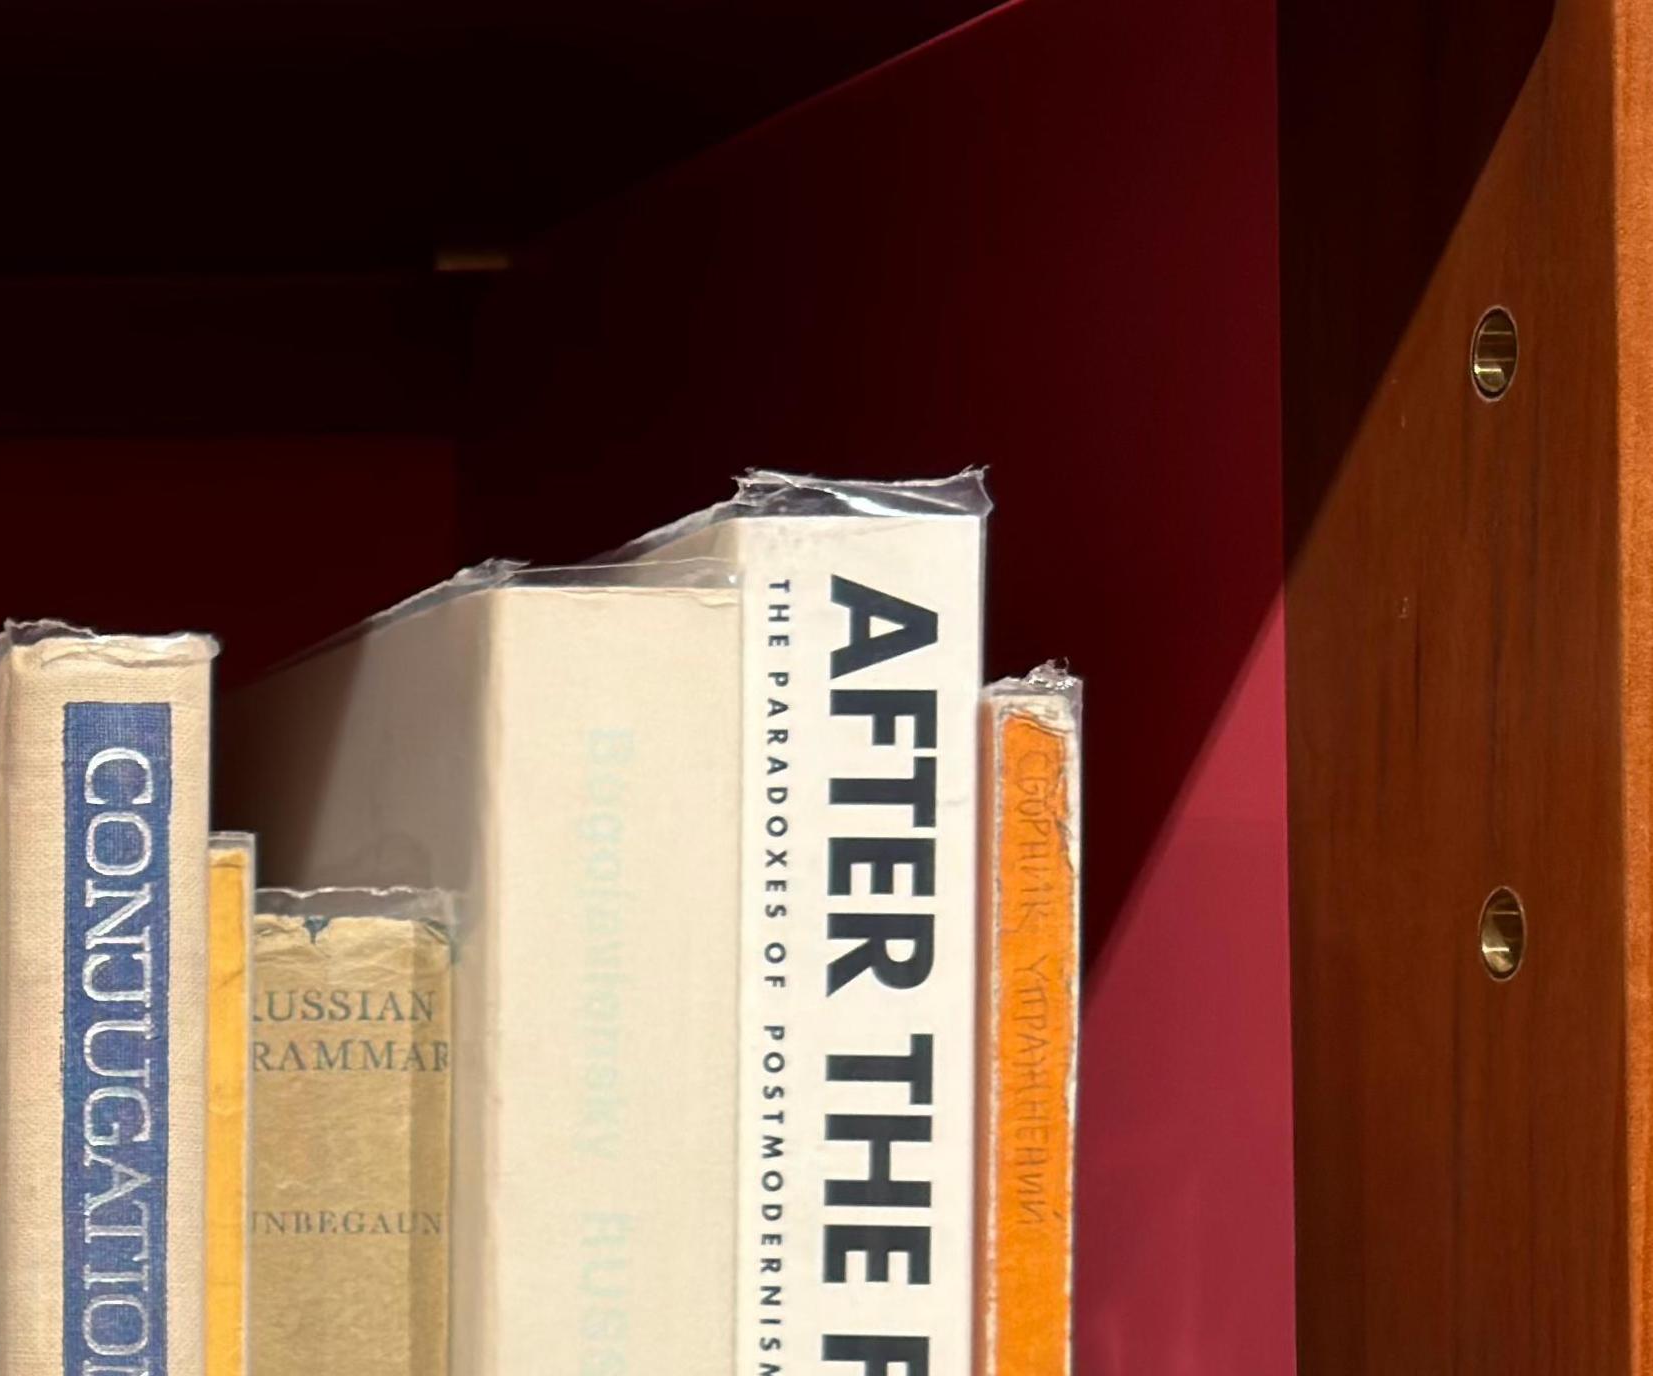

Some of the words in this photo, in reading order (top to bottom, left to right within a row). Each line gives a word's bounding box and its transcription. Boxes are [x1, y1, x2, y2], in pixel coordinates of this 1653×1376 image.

[765, 579, 792, 648] THE
[763, 672, 791, 920] PARADOXES
[825, 573, 940, 998] AFTER
[252, 989, 437, 1023] USSIAN
[763, 941, 788, 990] OF
[821, 1032, 935, 1286] THE
